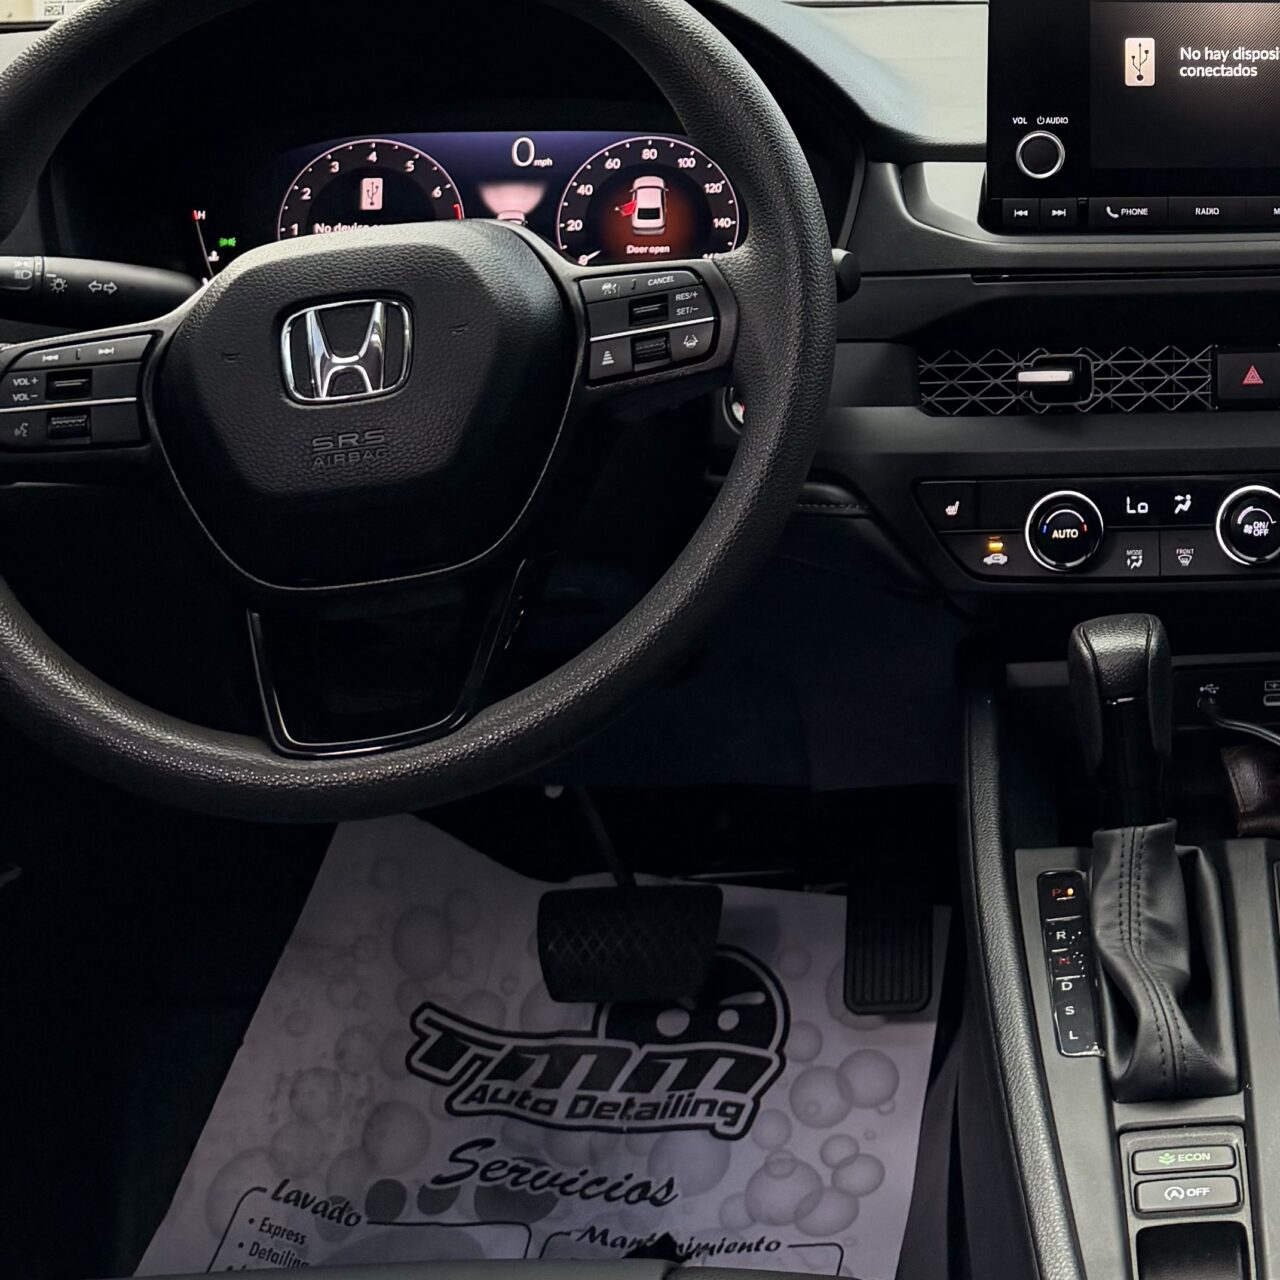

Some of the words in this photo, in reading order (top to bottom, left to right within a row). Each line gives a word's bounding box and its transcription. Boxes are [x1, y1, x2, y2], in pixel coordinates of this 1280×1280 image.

[1179, 46, 1200, 61] No
[1204, 46, 1229, 62] hay
[1179, 63, 1258, 77] conectados
[1012, 116, 1028, 125] VOL
[1045, 116, 1069, 125] AUDIO
[366, 151, 378, 163] 4
[511, 137, 535, 167] 0
[533, 157, 553, 168] mph
[642, 149, 658, 160] 80
[329, 161, 340, 174] 3
[404, 160, 415, 173] 5
[604, 158, 621, 170] 60
[677, 158, 697, 169] 100
[431, 186, 442, 198] 6
[576, 184, 593, 196] 40
[704, 181, 723, 194] 120
[300, 187, 312, 201] 2
[1120, 207, 1148, 216] PHONE
[1195, 207, 1219, 216] RADIO
[313, 222, 332, 234] No
[566, 219, 583, 232] 20
[713, 218, 732, 229] 140
[626, 245, 648, 254] Door
[648, 246, 671, 256] open
[647, 276, 675, 287] CANCEL
[312, 428, 385, 451] SRS
[313, 449, 389, 467] AIRBAG
[1126, 496, 1149, 514] Lo
[1052, 528, 1079, 539] AUTO
[1253, 528, 1269, 537] OFF
[1126, 549, 1143, 557] MODE
[1176, 548, 1194, 556] FRONT
[1055, 930, 1066, 941] R
[1061, 981, 1073, 992] D
[1065, 1005, 1076, 1016] S
[1068, 1030, 1080, 1041] L
[461, 1083, 558, 1119] Auto
[563, 1091, 747, 1127] Detailing
[1177, 1152, 1211, 1163] ECON
[431, 1138, 679, 1208] Servicios
[1186, 1187, 1211, 1197] OFF
[271, 1179, 362, 1227] Lavado
[258, 1217, 307, 1246] Express
